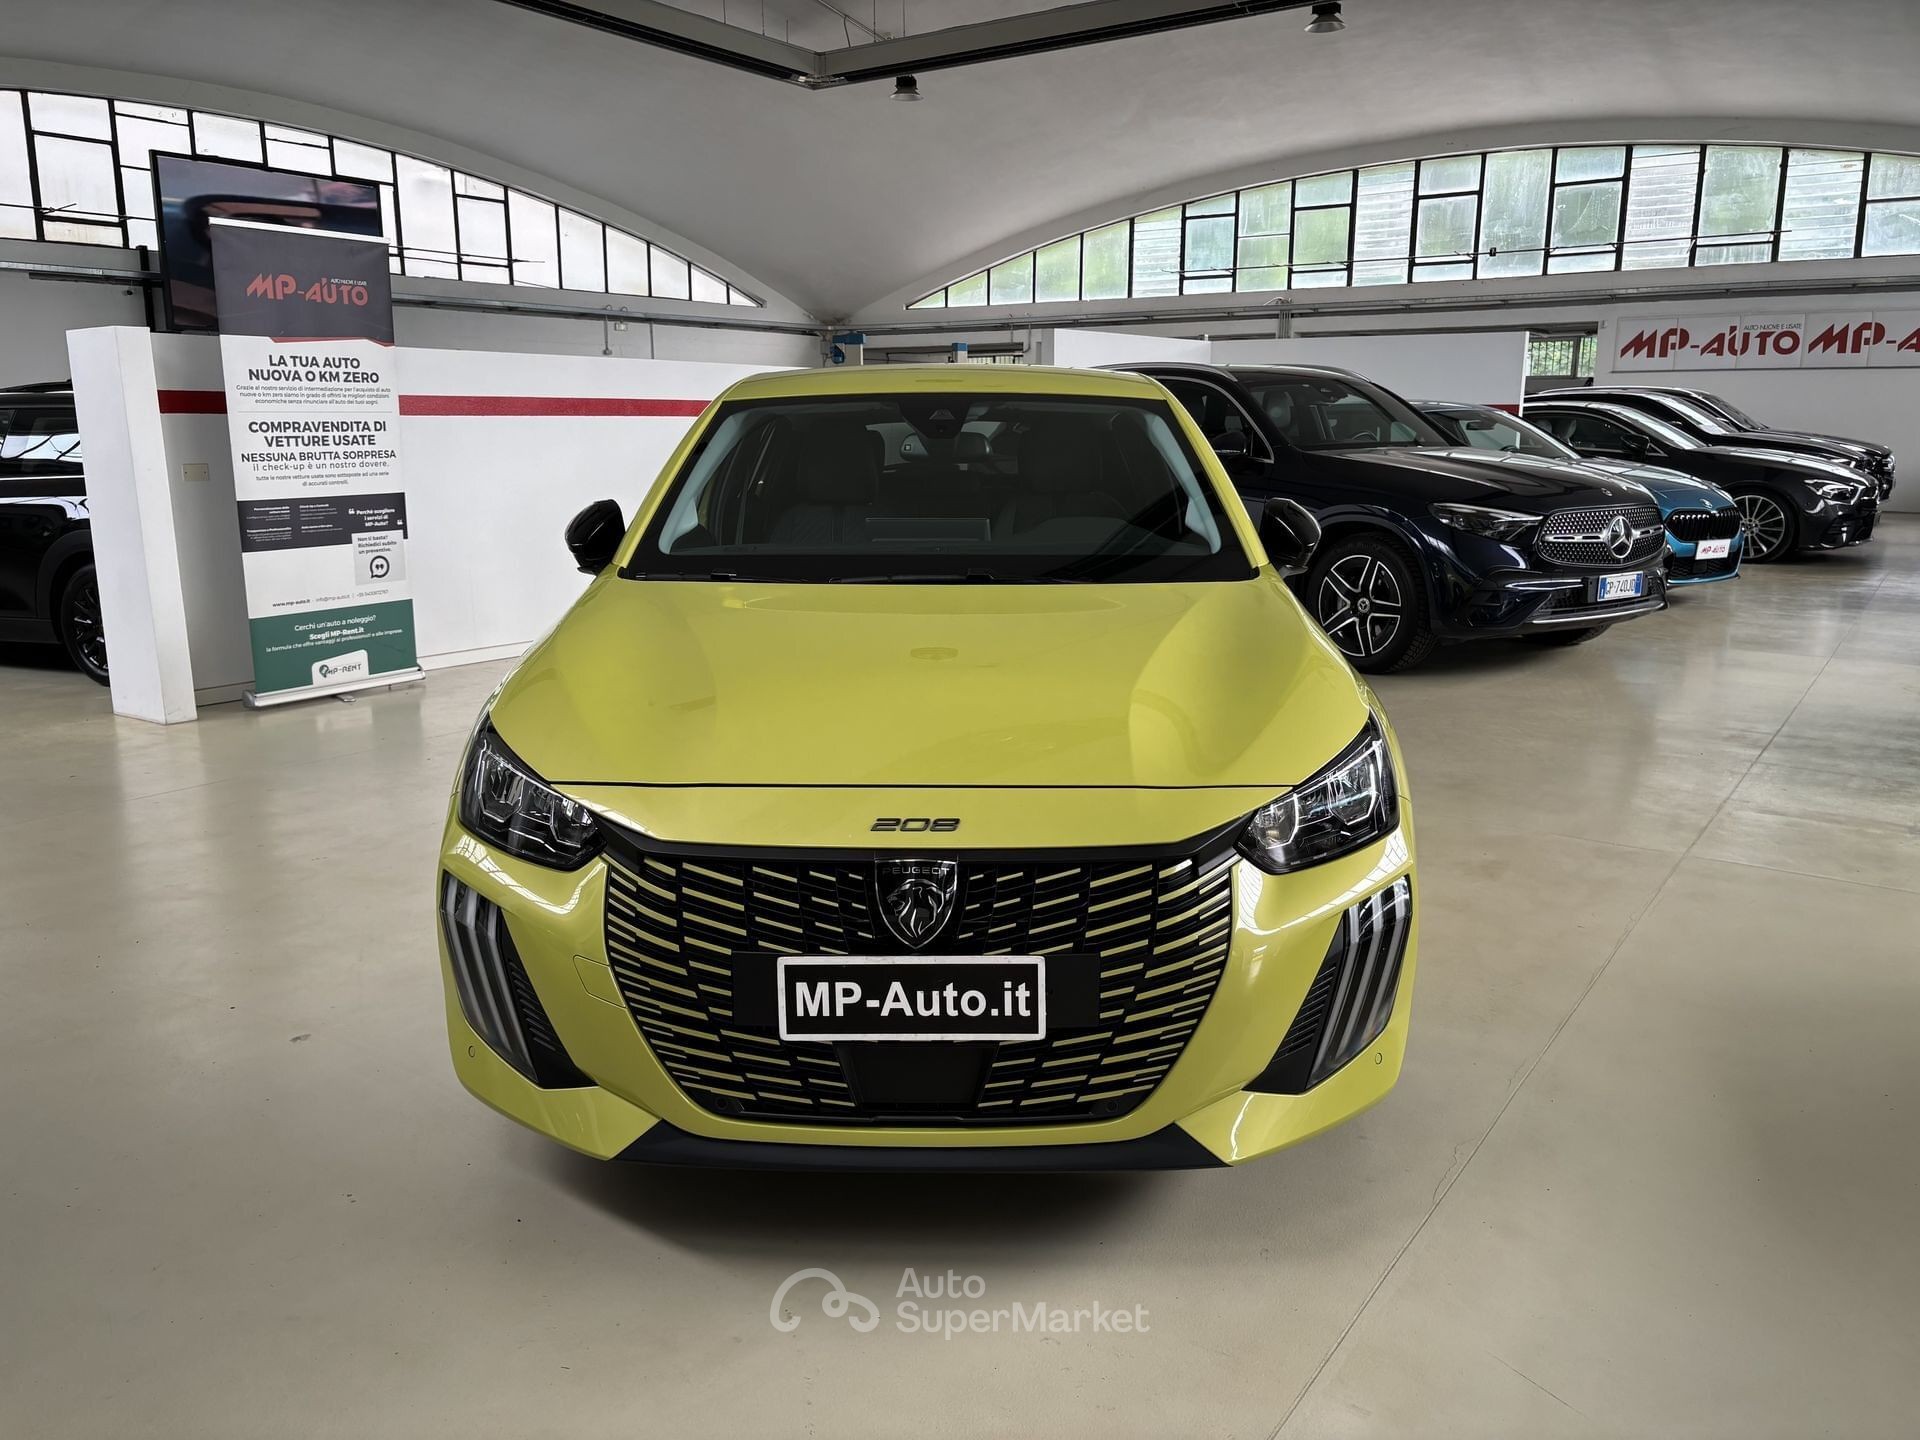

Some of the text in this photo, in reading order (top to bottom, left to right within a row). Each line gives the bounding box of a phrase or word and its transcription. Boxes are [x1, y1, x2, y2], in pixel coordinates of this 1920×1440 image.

[269, 354, 361, 369] LA TUA AUTO
[248, 369, 302, 382] NUOVA
[319, 371, 341, 383] KM
[343, 372, 380, 384] ZERO
[248, 421, 387, 433] COMPRAVENDITA DI
[264, 435, 376, 447] VETTURE USATE
[241, 450, 397, 463] NESSUNA BRUTTA SORPRESA
[253, 463, 259, 471] il
[262, 462, 305, 472] check-up
[329, 461, 357, 469] nostro
[294, 622, 316, 632] Cerchi
[316, 620, 341, 629] un'auto
[347, 614, 377, 624] noleggio?
[309, 626, 365, 640] Scegli MP-Rent.it
[871, 817, 961, 832] 208
[882, 866, 950, 875] PEUGEOT
[794, 980, 1032, 1017] MP-Auto.it
